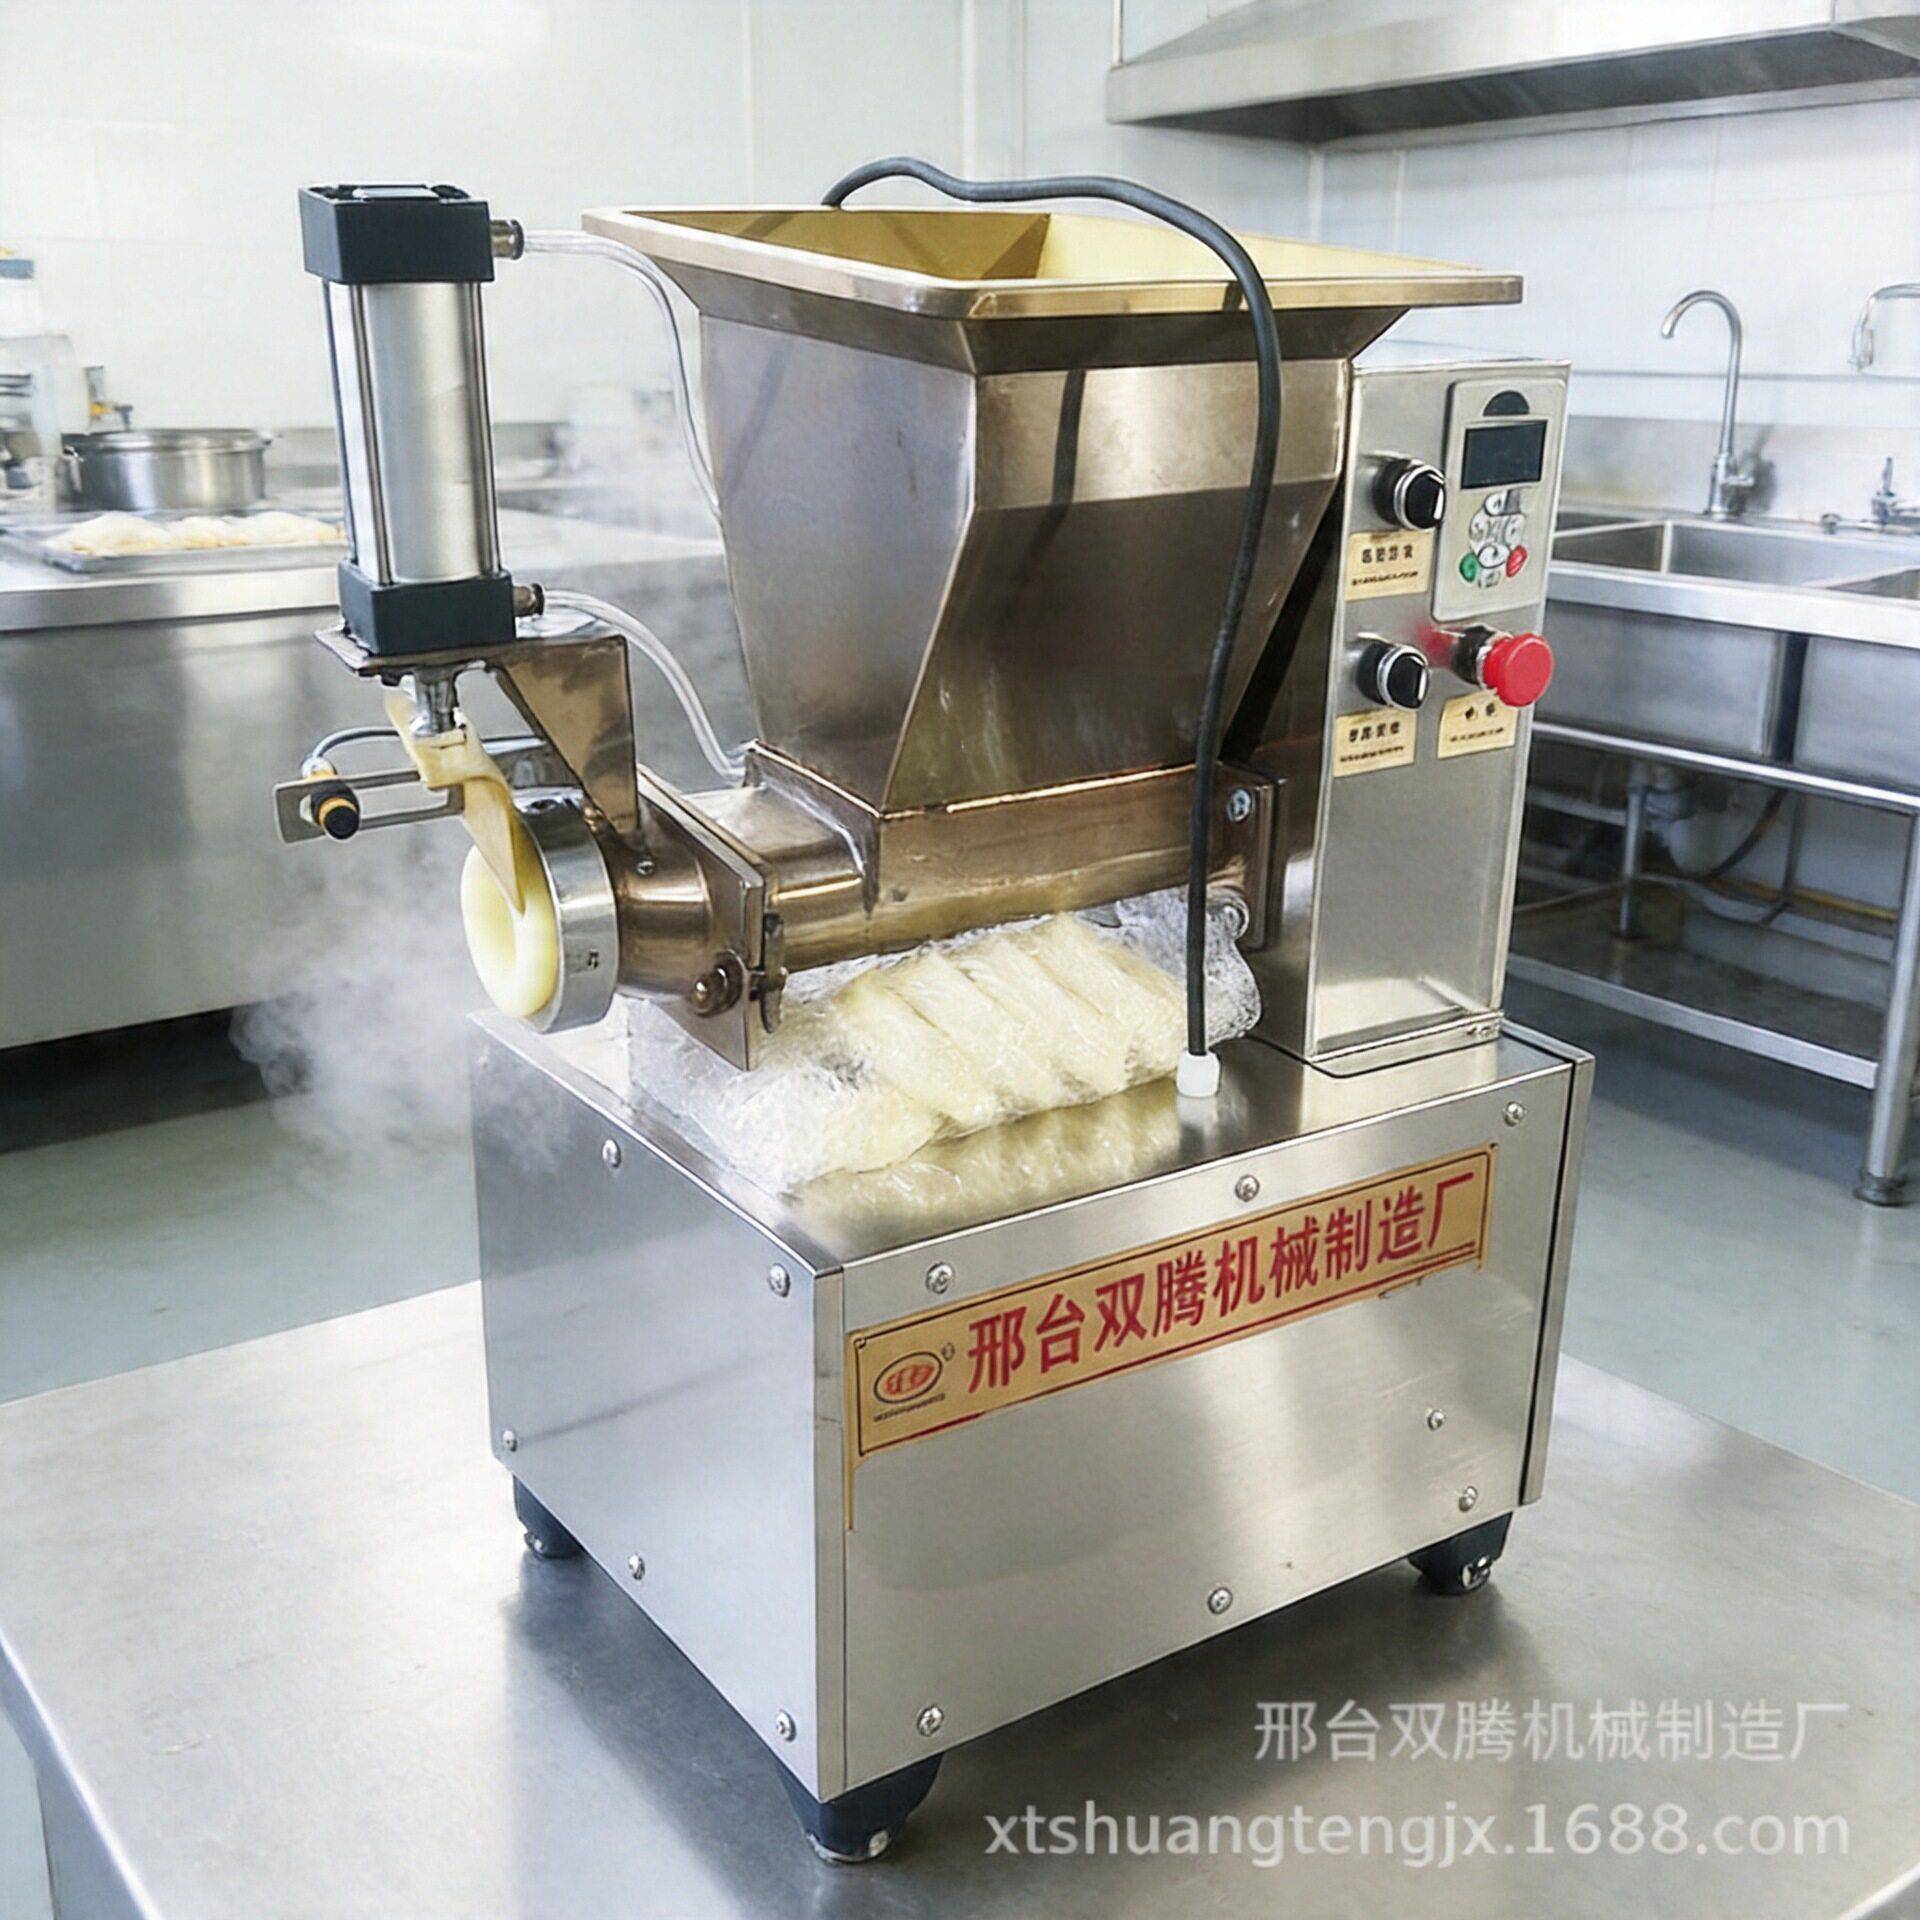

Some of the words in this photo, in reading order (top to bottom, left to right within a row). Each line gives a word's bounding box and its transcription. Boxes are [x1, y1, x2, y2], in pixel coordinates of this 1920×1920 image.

[967, 1171, 1474, 1393] 邢台双腾机械制造厂
